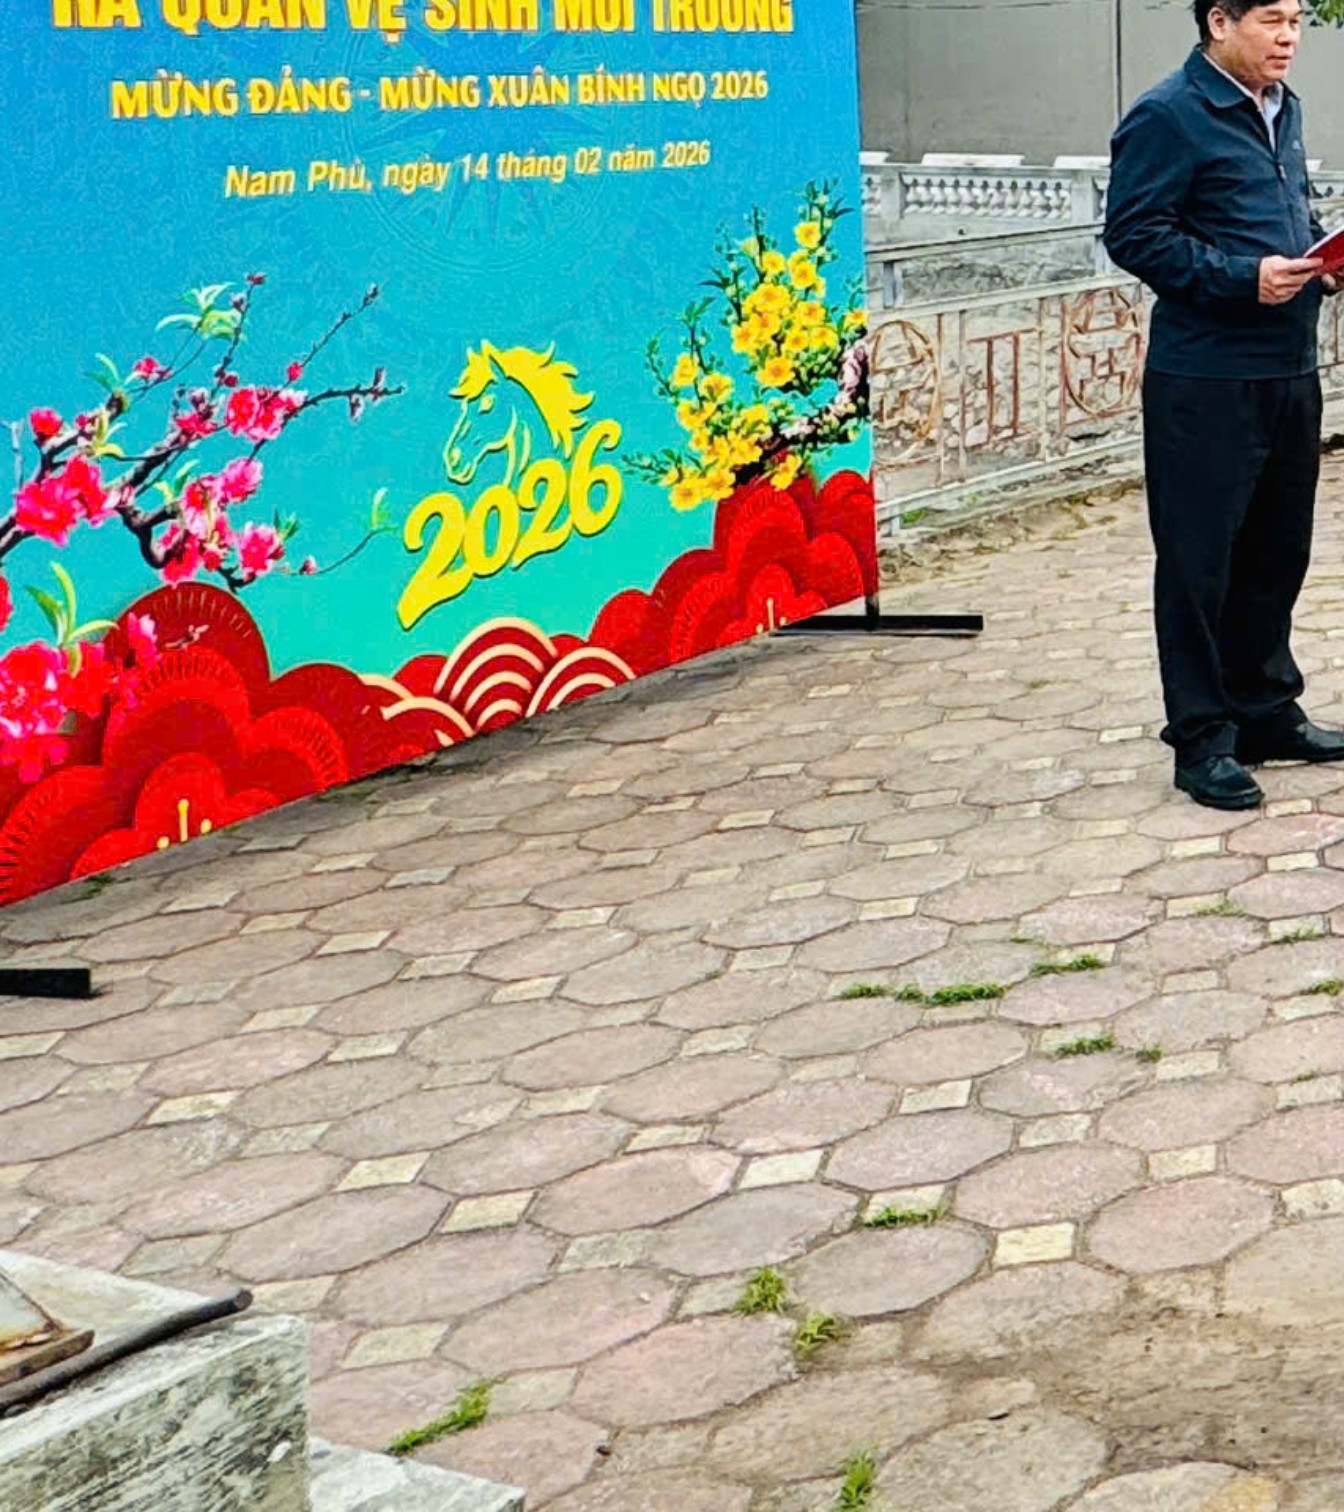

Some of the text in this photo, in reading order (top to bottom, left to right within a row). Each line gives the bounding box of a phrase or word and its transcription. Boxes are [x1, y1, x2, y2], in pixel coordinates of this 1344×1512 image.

[111, 63, 769, 119] MỪNG ĐẢNG - MỪNG XUÂN BÍNH NGỌ 2026
[225, 165, 295, 198] Nam
[383, 153, 450, 195] ngày
[461, 152, 489, 183] 14
[496, 147, 567, 183] tháng
[574, 146, 602, 174] 02
[608, 143, 655, 171] năm
[661, 139, 711, 167] 2026
[396, 419, 622, 631] 2026
